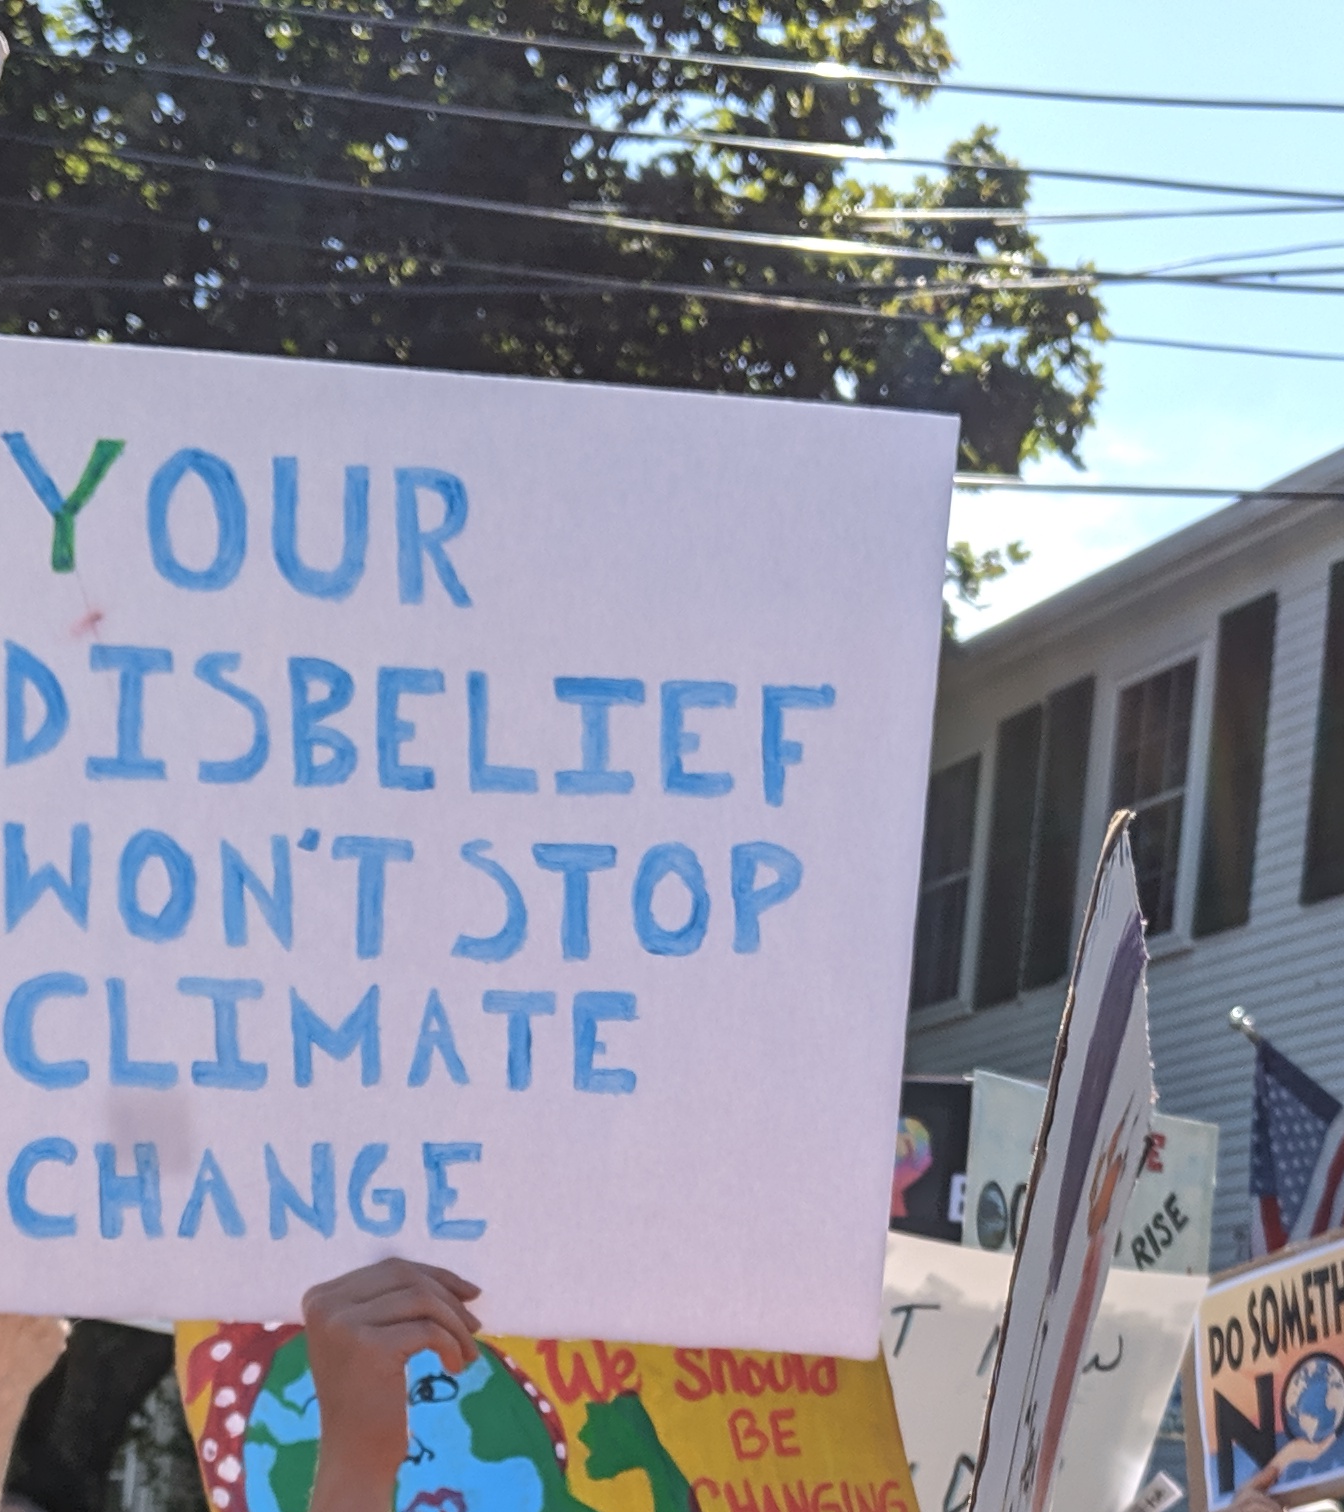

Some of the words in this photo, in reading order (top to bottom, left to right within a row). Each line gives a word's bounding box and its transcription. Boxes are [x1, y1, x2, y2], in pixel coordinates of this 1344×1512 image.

[0, 430, 473, 608] YOUR
[3, 639, 837, 806] DISBELIEF
[3, 822, 415, 960] WON'T
[451, 838, 804, 962] STOP
[1, 969, 638, 1094] CLIMATE
[5, 1135, 488, 1240] CHANGE
[1131, 1191, 1190, 1272] RISE
[537, 1339, 643, 1405] We
[1208, 1316, 1244, 1377] DO
[728, 1408, 802, 1462] BE
